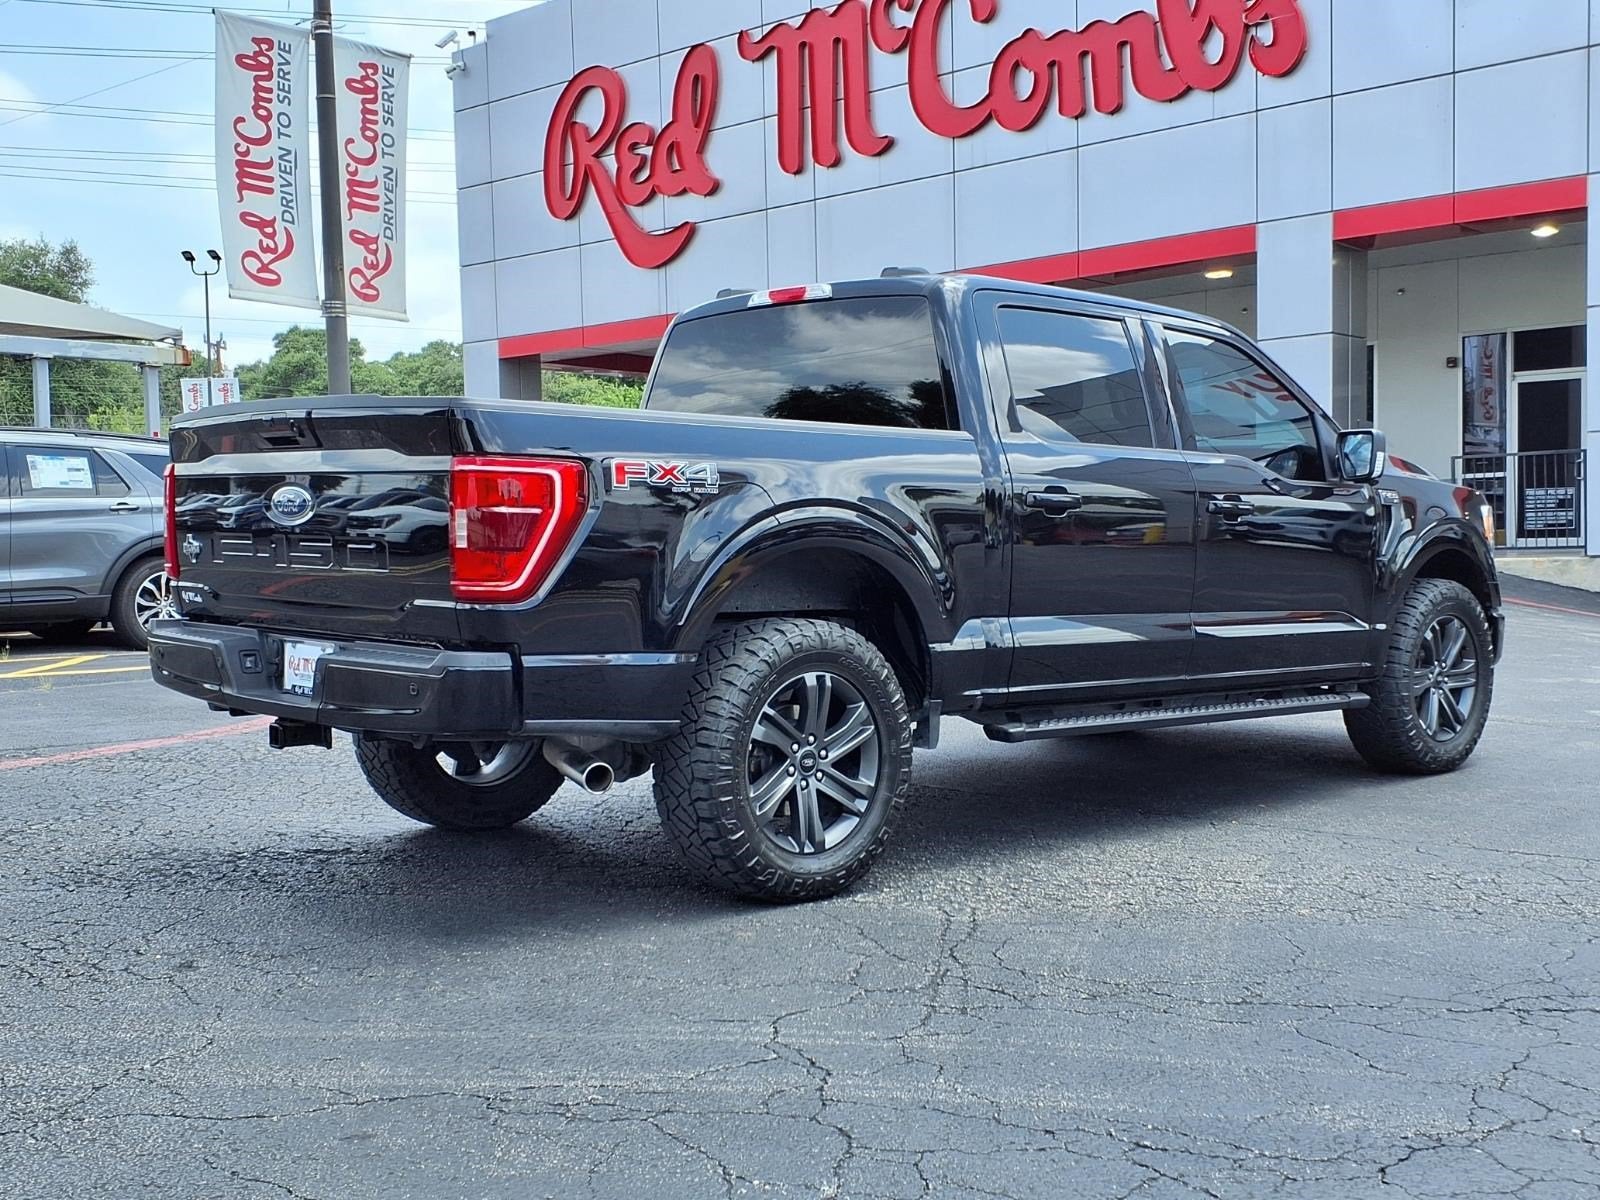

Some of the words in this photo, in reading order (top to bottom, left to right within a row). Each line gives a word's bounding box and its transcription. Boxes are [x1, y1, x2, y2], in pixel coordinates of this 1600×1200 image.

[277, 39, 292, 107] SERVE
[381, 64, 395, 125] SERVE
[233, 36, 275, 203] McCombs
[277, 112, 292, 139] TO
[344, 61, 380, 221] McCombs
[382, 132, 395, 160] TO
[544, 43, 720, 269] Red
[736, 0, 1309, 175] McCombs
[277, 147, 295, 226] DRIVEN
[382, 165, 395, 242] DRIVEN
[240, 211, 295, 287] Red
[349, 229, 393, 303] Red
[187, 384, 198, 411] Combs
[611, 458, 720, 490] FX4
